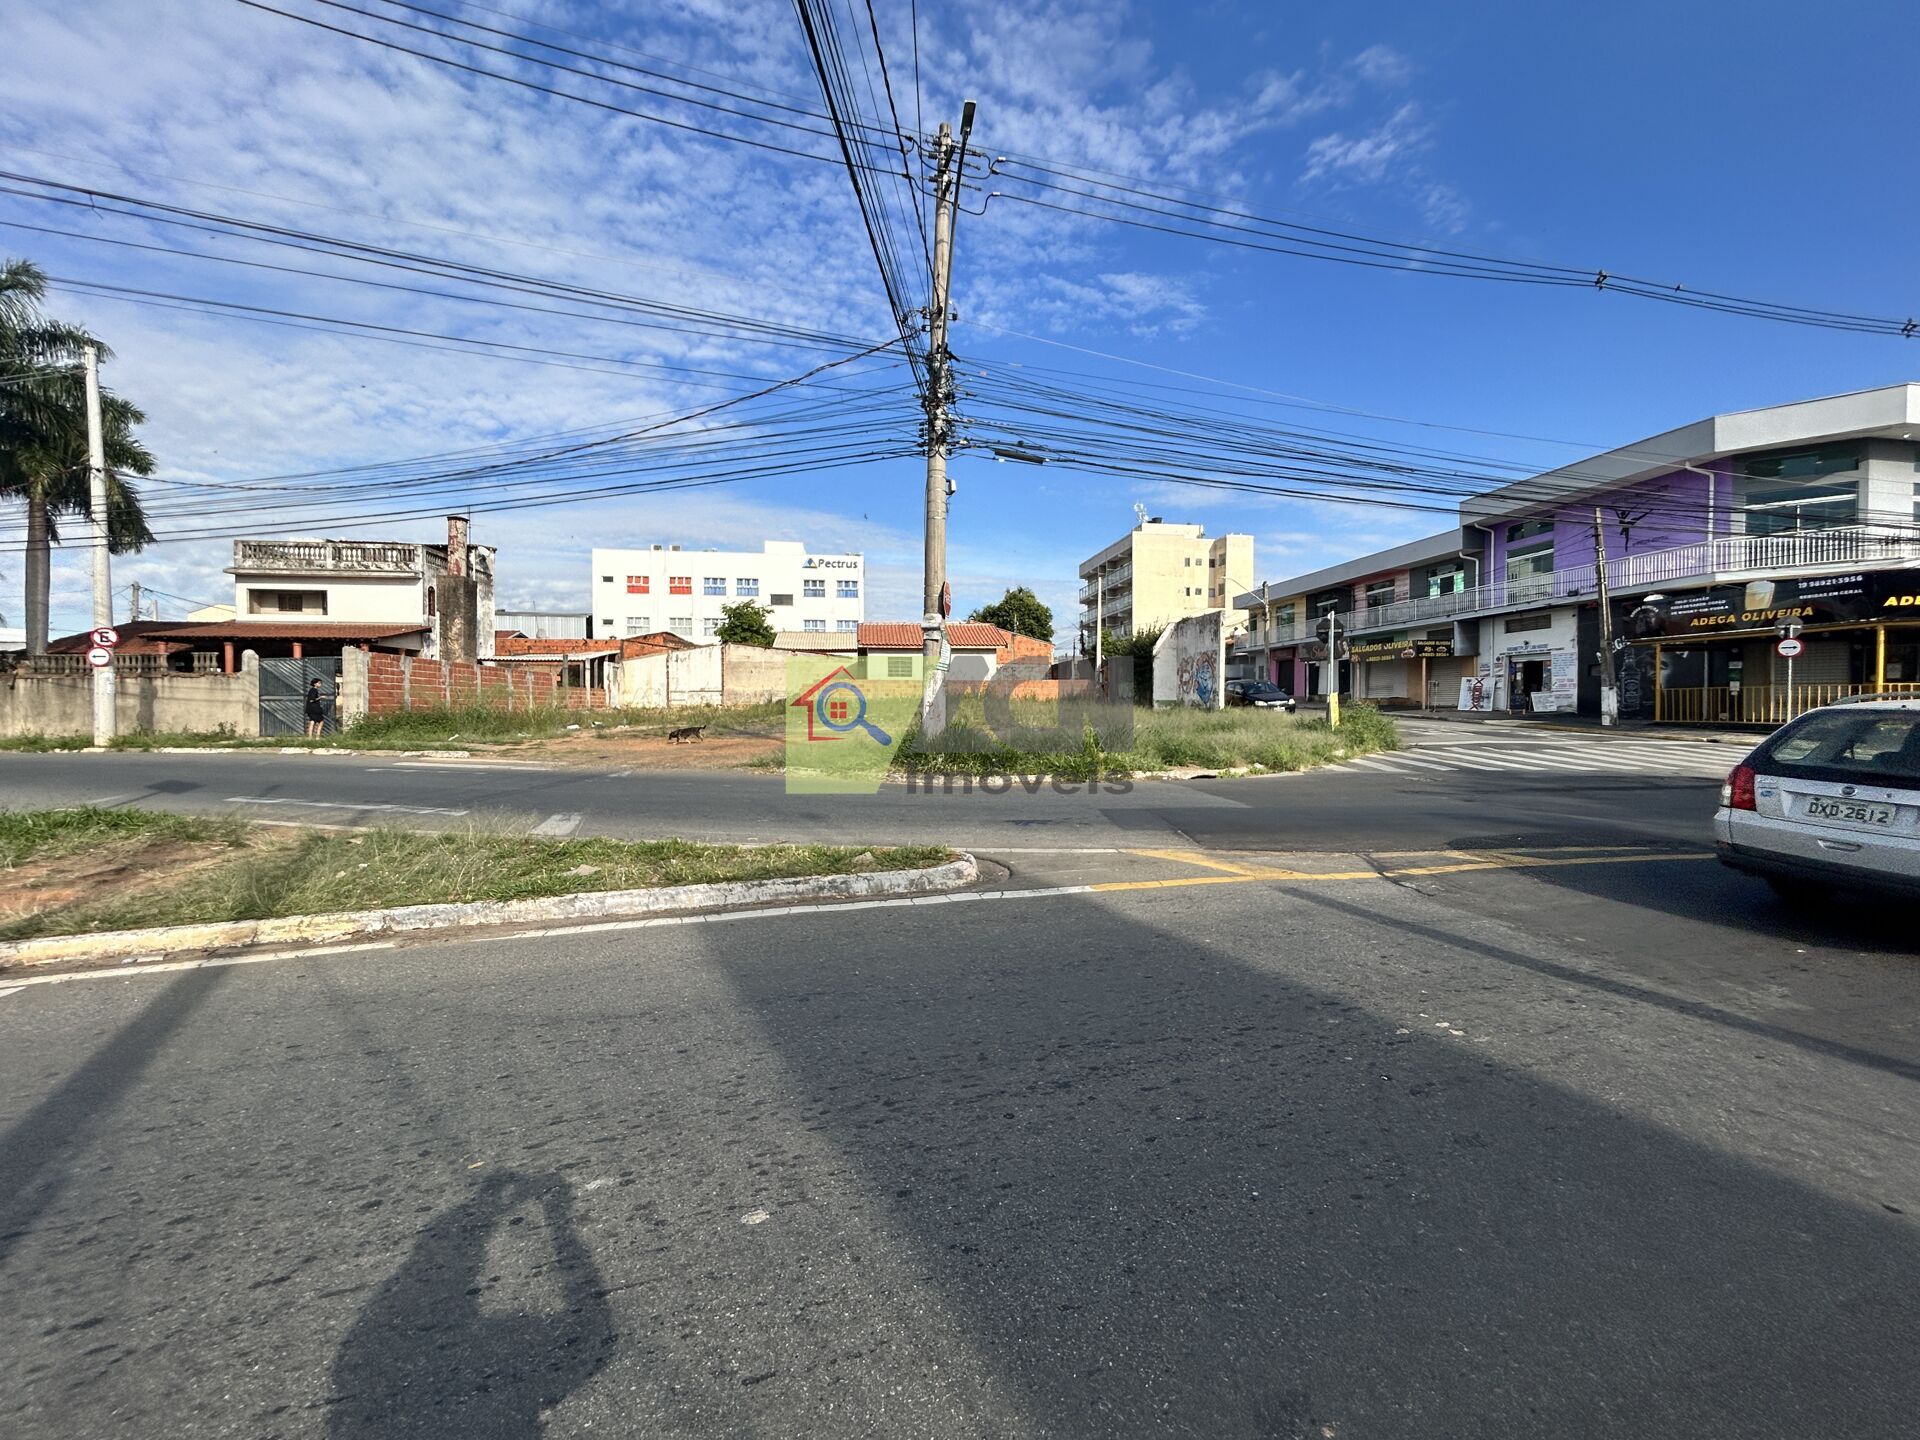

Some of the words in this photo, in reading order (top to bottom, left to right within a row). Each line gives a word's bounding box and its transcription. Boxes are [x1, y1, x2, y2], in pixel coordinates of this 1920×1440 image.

[817, 558, 858, 569] Pectrus
[1690, 614, 1736, 627] ADEGA
[1741, 606, 1815, 622] OLIVEIRA
[100, 631, 109, 643] E
[1351, 643, 1383, 654] SALGADOS
